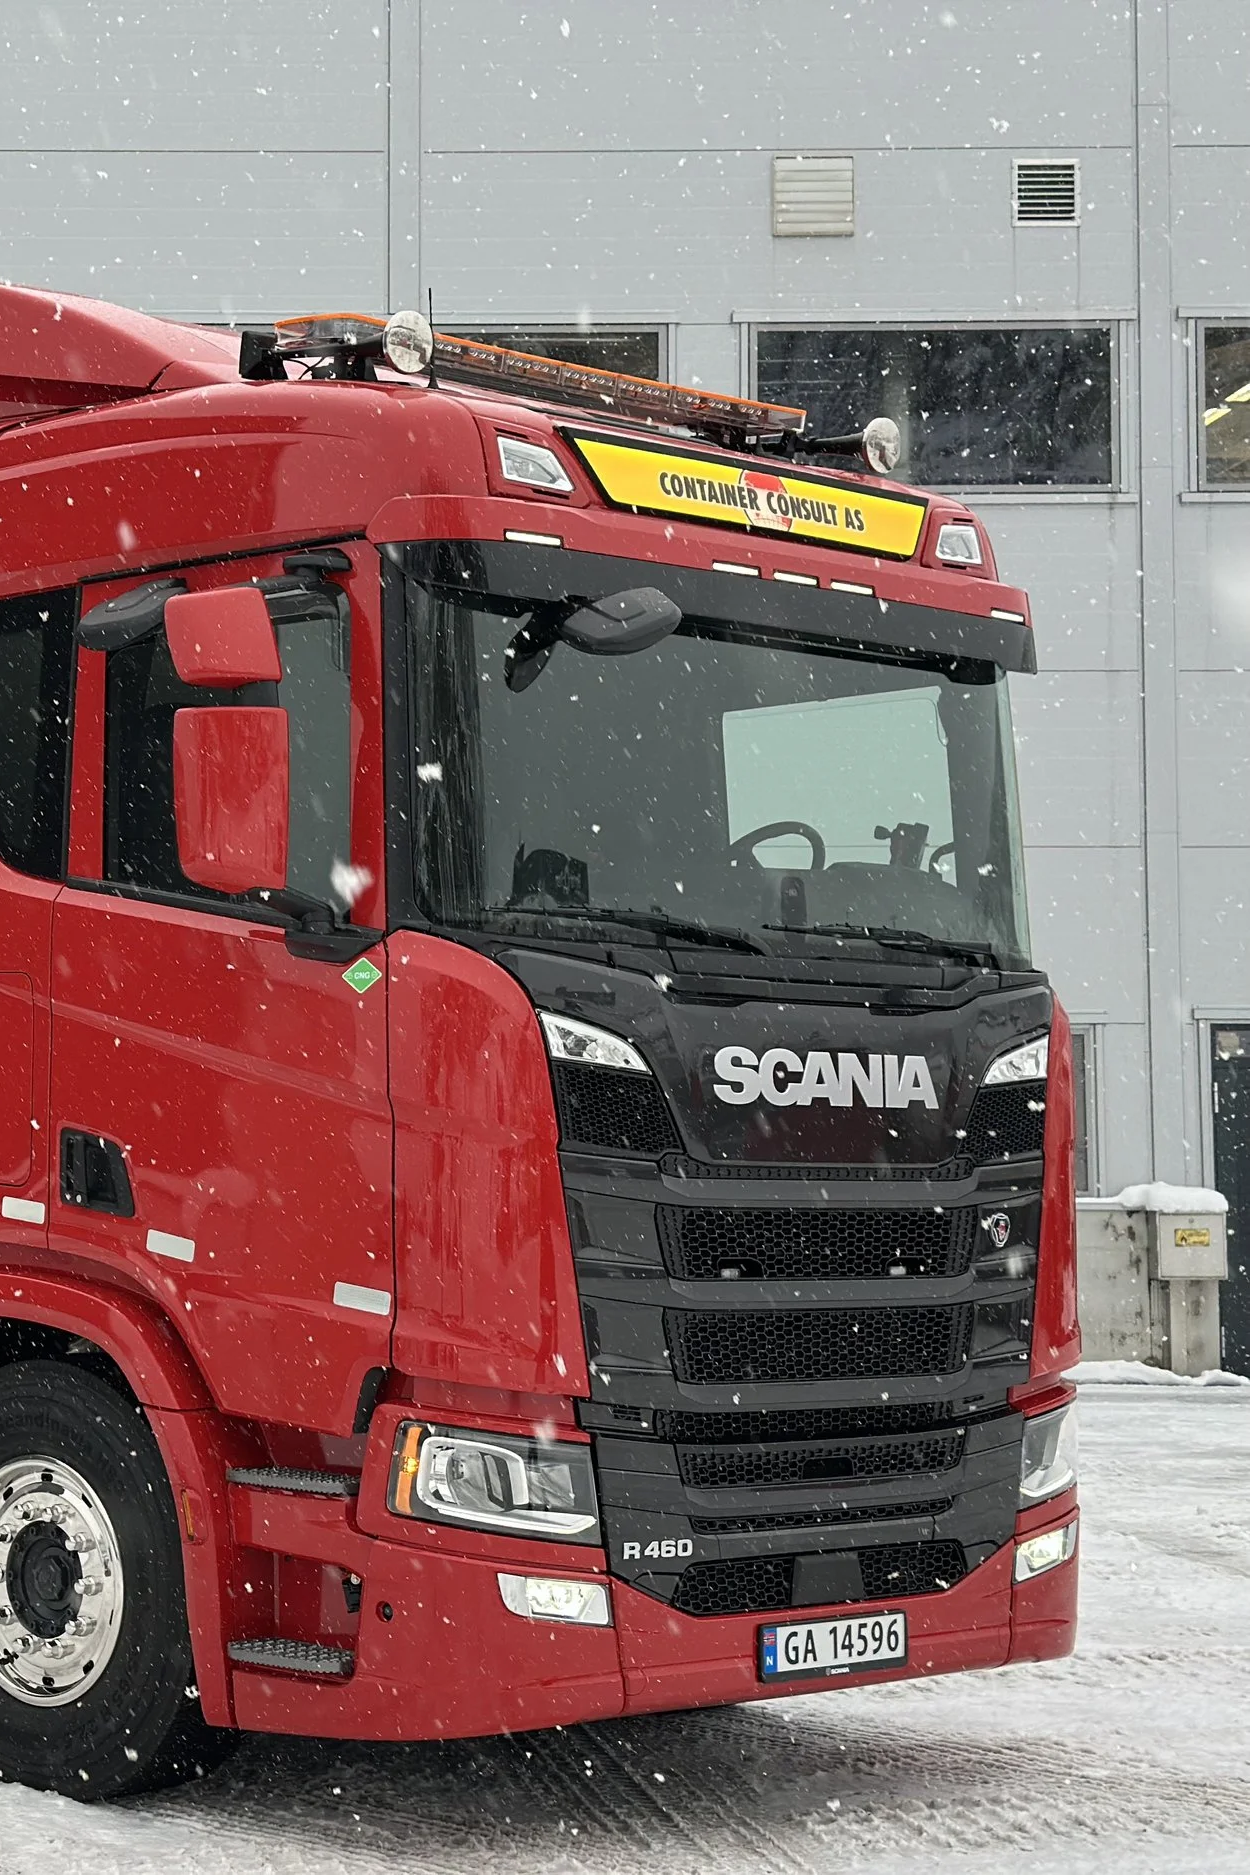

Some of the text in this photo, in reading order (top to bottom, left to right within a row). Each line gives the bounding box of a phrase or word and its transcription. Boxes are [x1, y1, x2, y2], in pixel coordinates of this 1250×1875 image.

[659, 472, 865, 532] CONTAINER CONSULT AS
[713, 1045, 940, 1110] SCANIA
[623, 1538, 693, 1560] R 460
[765, 1655, 774, 1667] N
[784, 1618, 899, 1665] GA 14596
